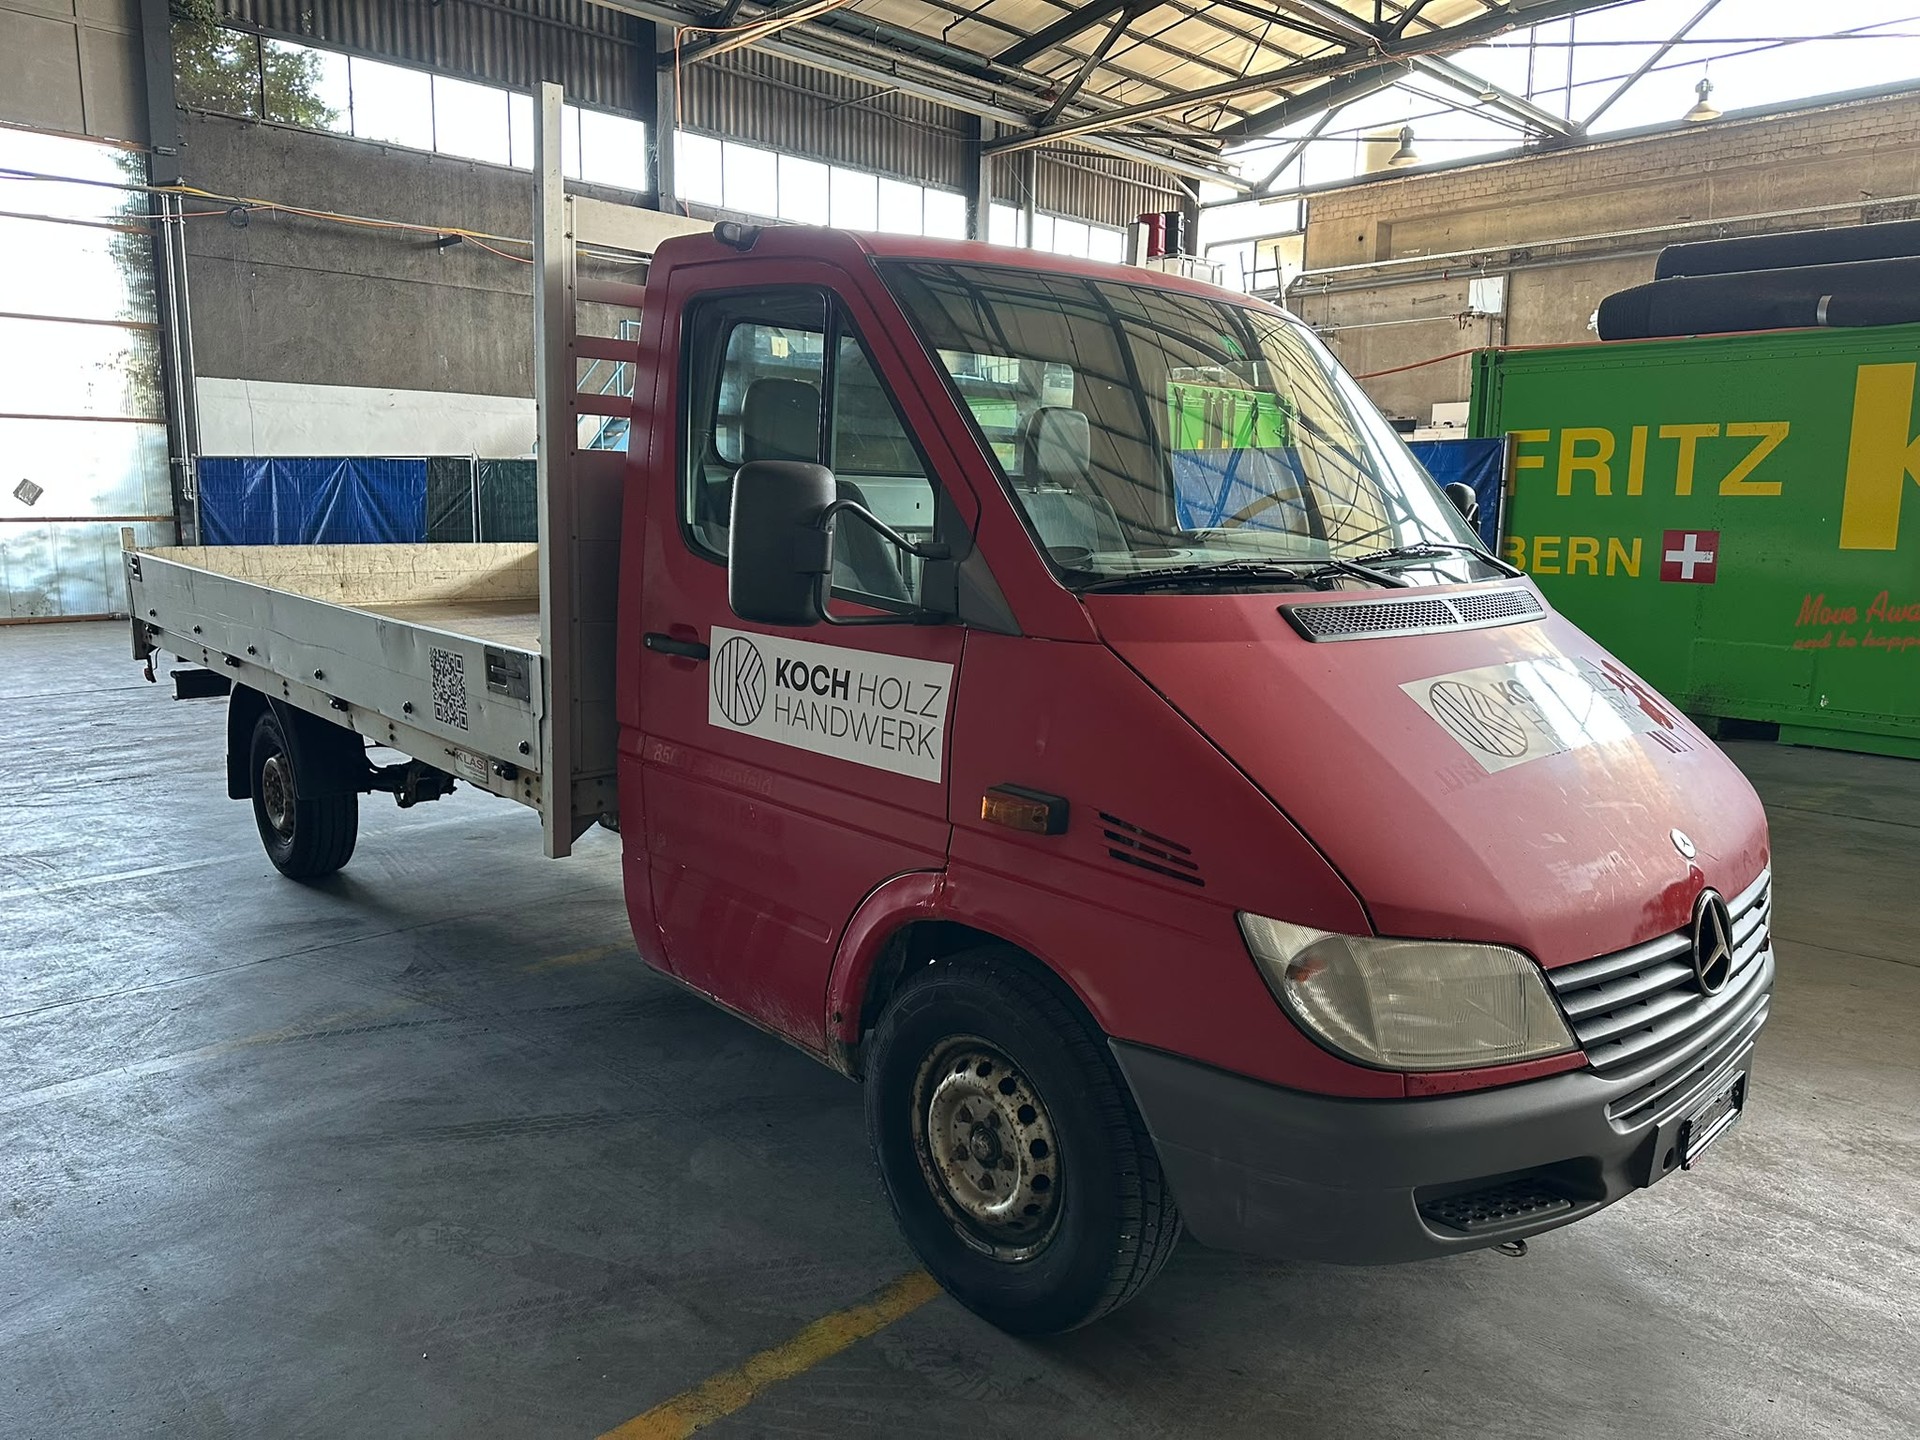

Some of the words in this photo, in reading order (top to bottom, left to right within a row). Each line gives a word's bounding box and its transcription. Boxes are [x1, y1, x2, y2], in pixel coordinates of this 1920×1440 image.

[1507, 421, 1790, 496] FRITZ
[775, 657, 851, 701] KOCH
[857, 672, 943, 719] HOLZ
[774, 693, 937, 760] HANDWERK
